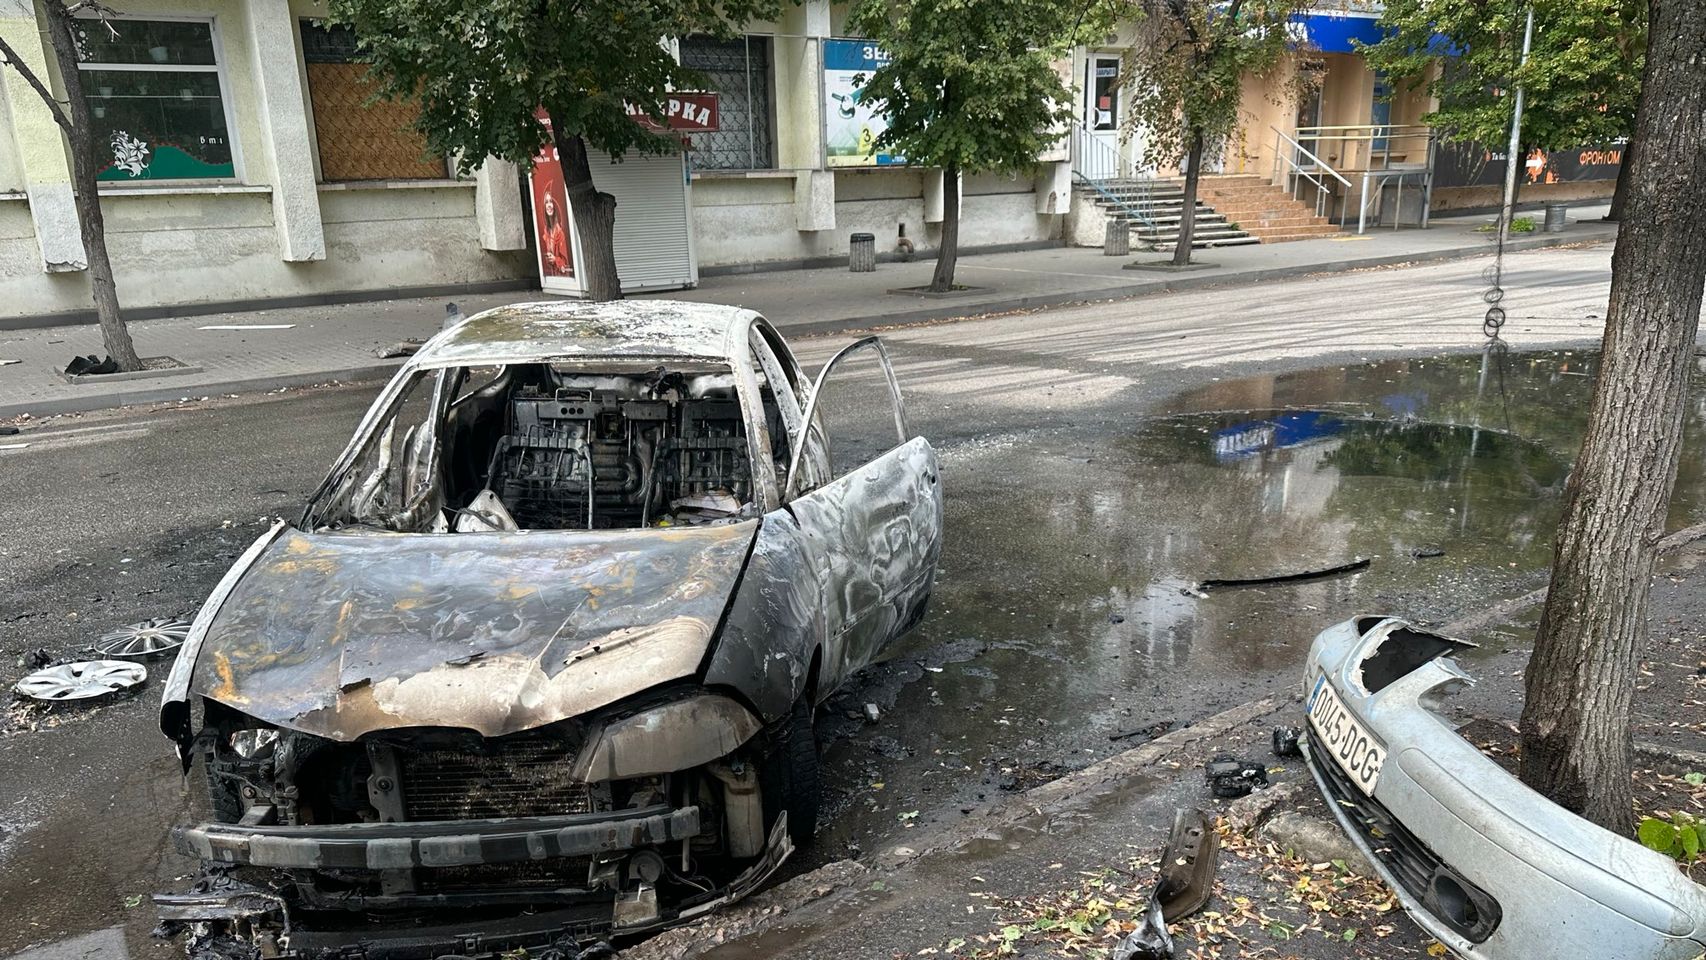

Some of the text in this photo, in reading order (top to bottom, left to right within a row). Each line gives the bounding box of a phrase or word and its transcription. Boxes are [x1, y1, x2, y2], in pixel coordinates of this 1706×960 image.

[862, 128, 872, 143] 3
[1313, 688, 1379, 783] 0045 DCG
